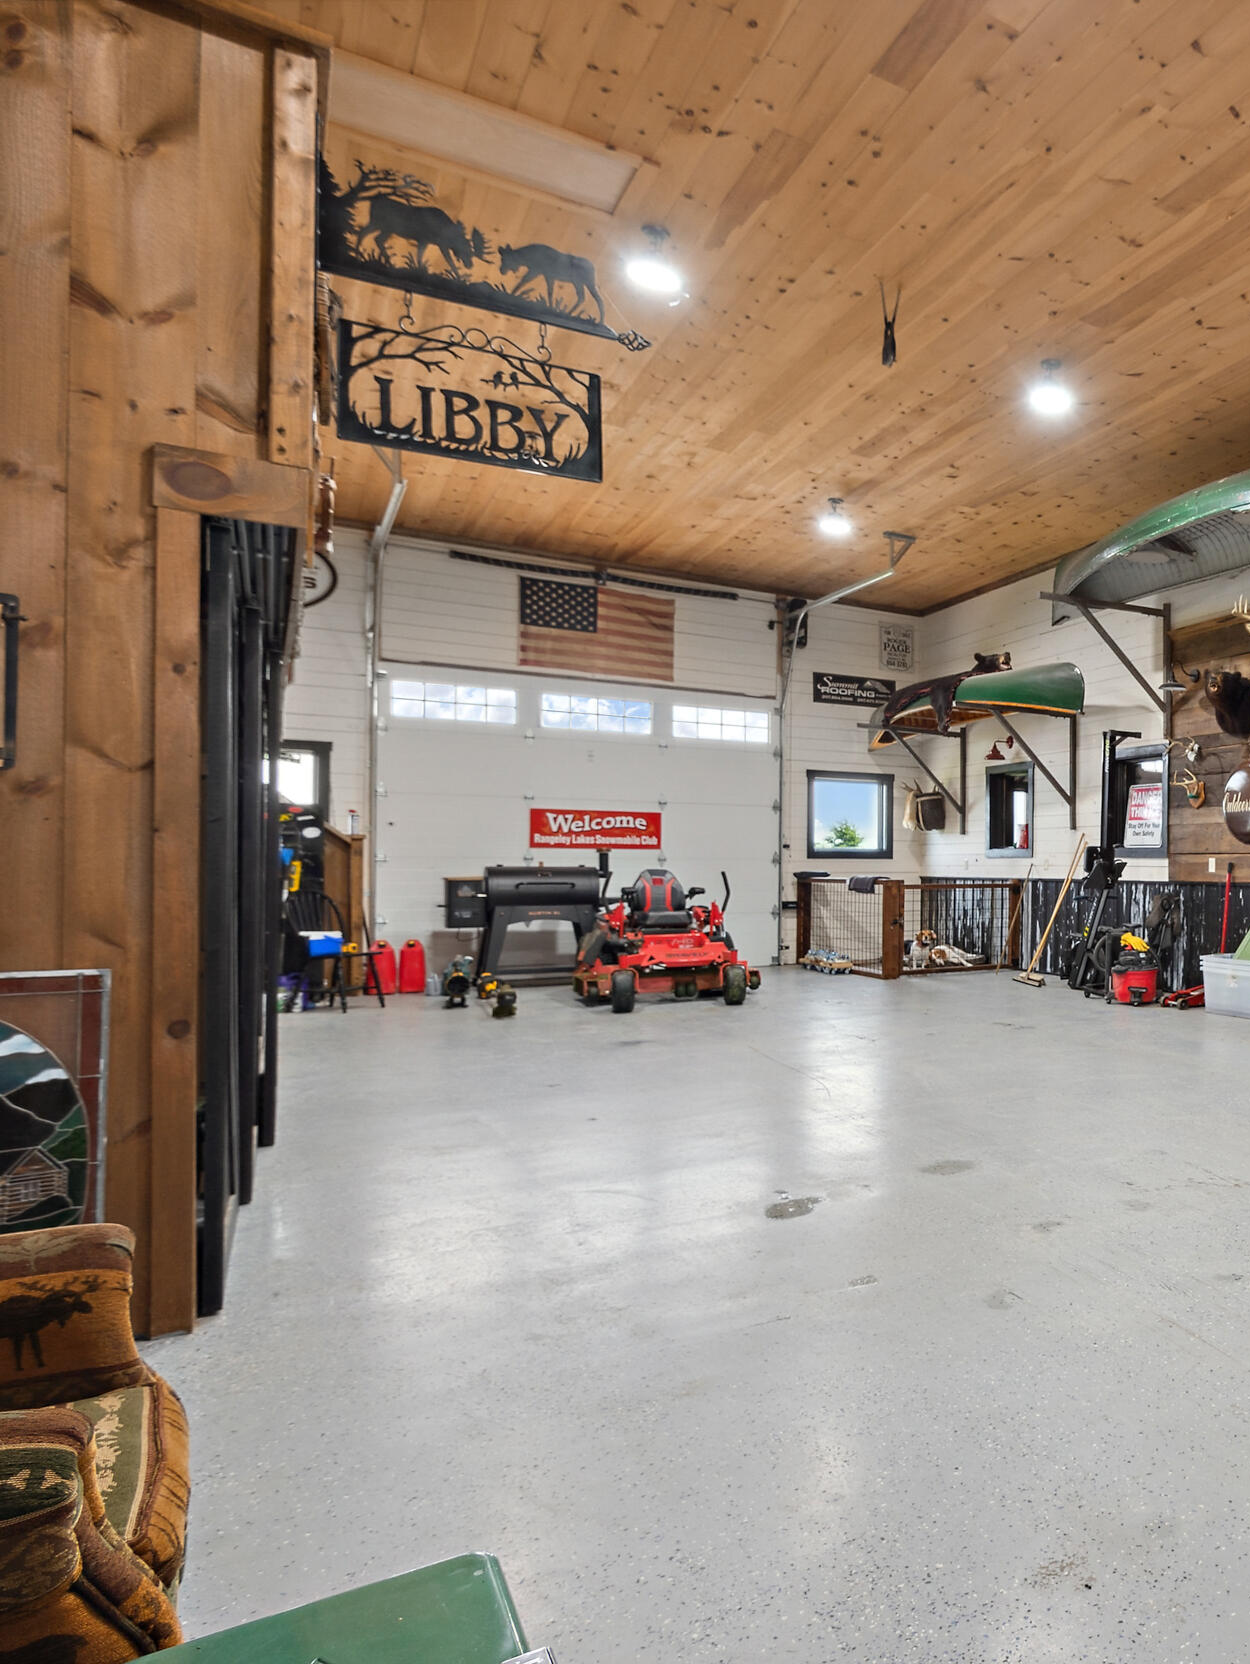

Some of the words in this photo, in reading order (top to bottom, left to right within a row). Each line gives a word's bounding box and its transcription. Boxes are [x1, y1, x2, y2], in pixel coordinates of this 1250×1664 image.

[373, 374, 570, 468] LIBBY
[884, 642, 910, 654] PAGE
[817, 676, 859, 690] Summit
[821, 687, 875, 698] ROOFING
[545, 812, 647, 833] Welcome
[534, 833, 571, 845] Rangeley
[572, 834, 595, 844] Lakes
[596, 834, 640, 845] Snowmobile
[641, 836, 658, 845] Club
